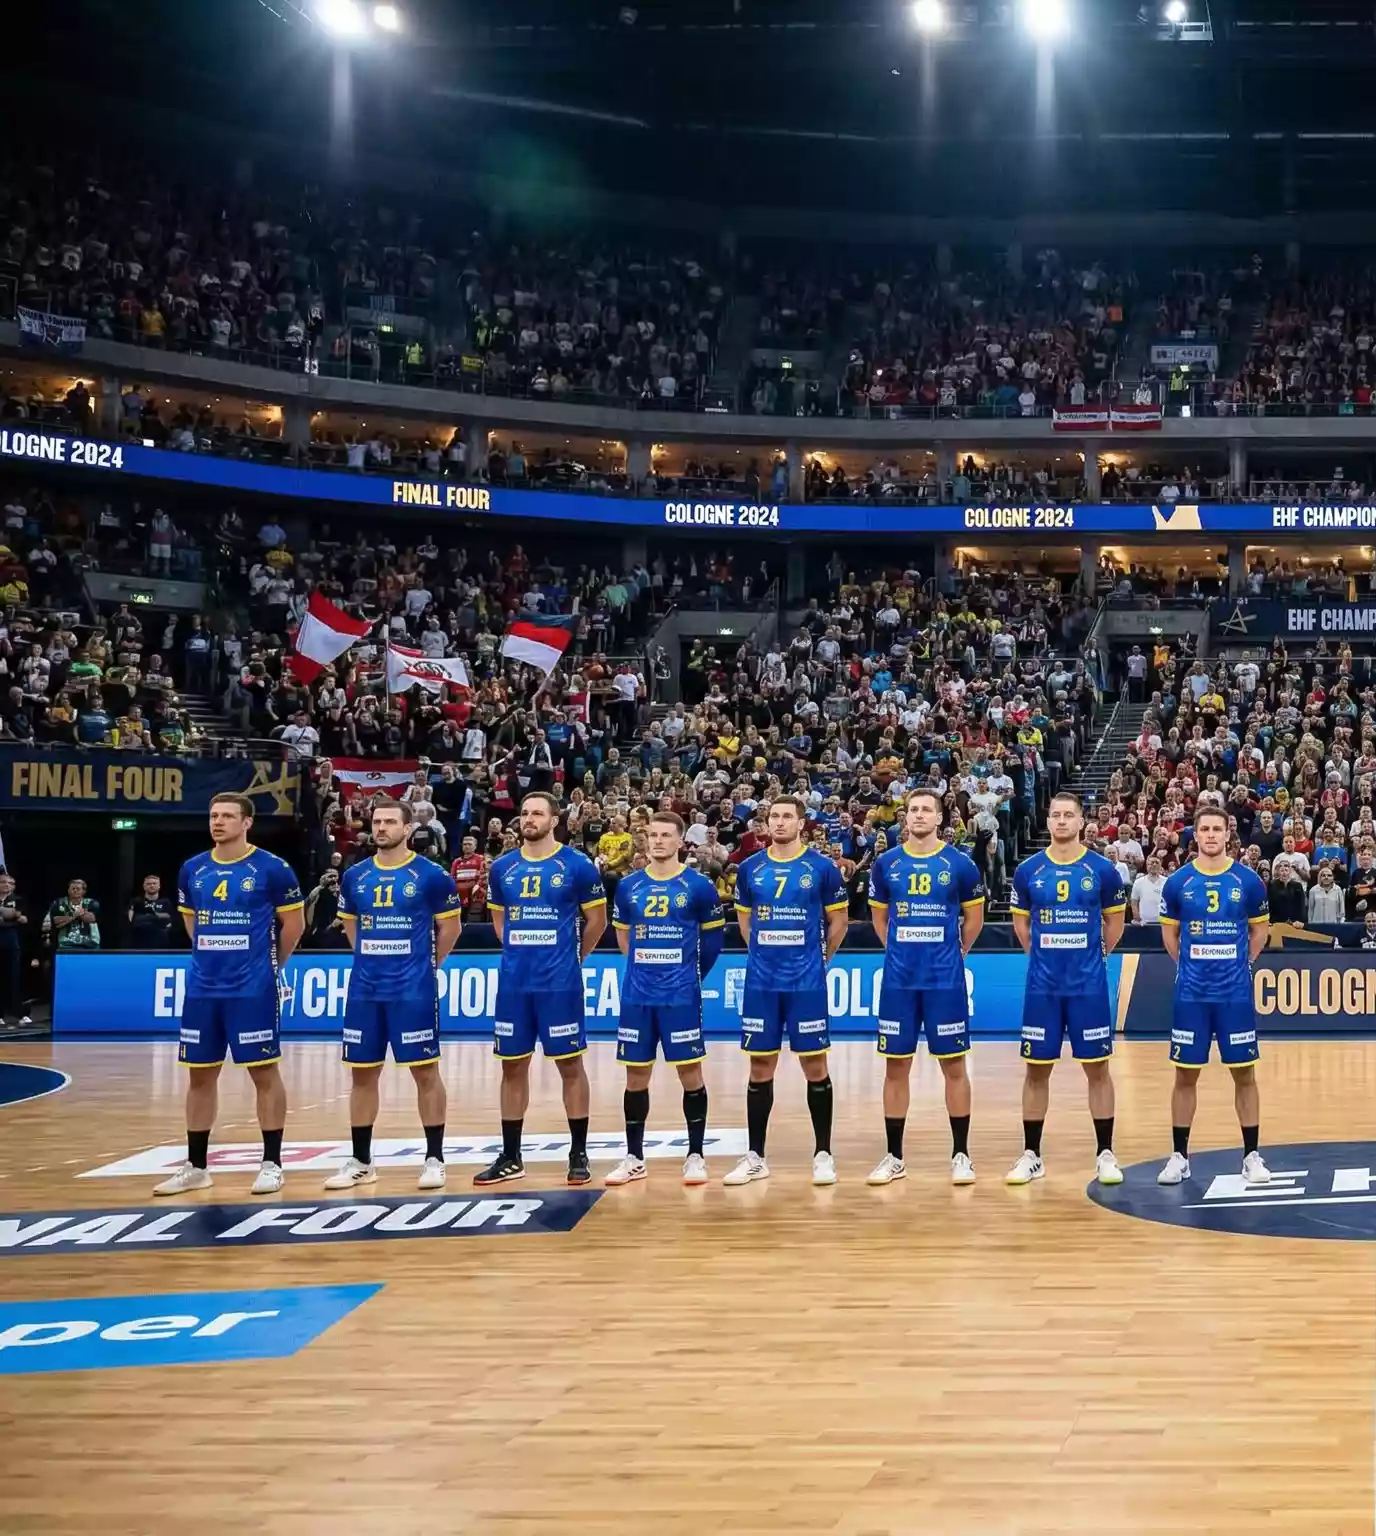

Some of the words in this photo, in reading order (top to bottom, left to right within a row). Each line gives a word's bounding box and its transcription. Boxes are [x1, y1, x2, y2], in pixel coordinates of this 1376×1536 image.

[70, 441, 123, 468] 2024
[393, 482, 441, 506] FINAL
[446, 487, 490, 510] FOUR
[665, 503, 734, 525] COLOGNE
[738, 506, 779, 526] 2024
[964, 508, 1031, 527] COLOGNE
[1034, 508, 1074, 527] 2024
[1273, 507, 1299, 527] EHF
[1288, 609, 1316, 631] EHF
[12, 762, 98, 799] FINAL
[106, 767, 183, 801] FOUR
[213, 880, 228, 901] 4
[775, 877, 787, 898] 7
[908, 873, 931, 895] 18
[1056, 880, 1069, 902] 9
[373, 885, 393, 907] 11
[644, 895, 669, 917] 23
[1206, 890, 1220, 913] 3
[744, 1033, 752, 1048] 7
[1023, 1043, 1031, 1056] 3
[1173, 1046, 1181, 1060] 2
[216, 1199, 543, 1239] FOUR
